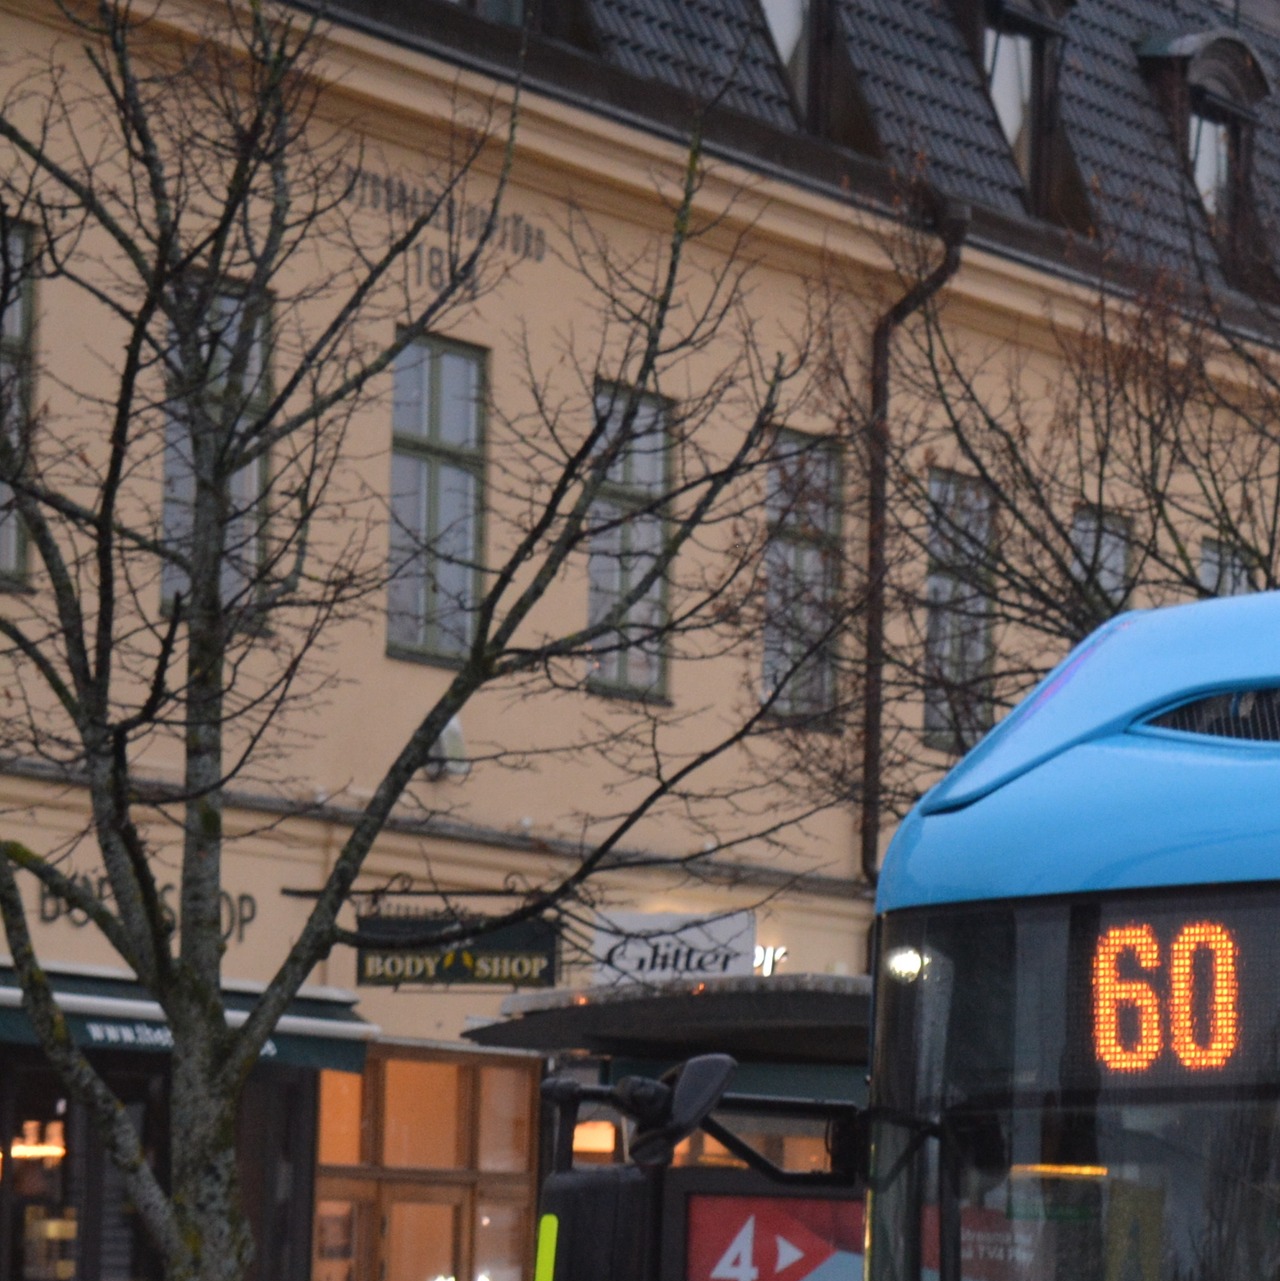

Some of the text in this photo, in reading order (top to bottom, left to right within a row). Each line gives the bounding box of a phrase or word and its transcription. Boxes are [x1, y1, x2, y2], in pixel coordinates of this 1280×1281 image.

[365, 955, 548, 979] BODY SHOP
[1093, 921, 1238, 1070] 60
